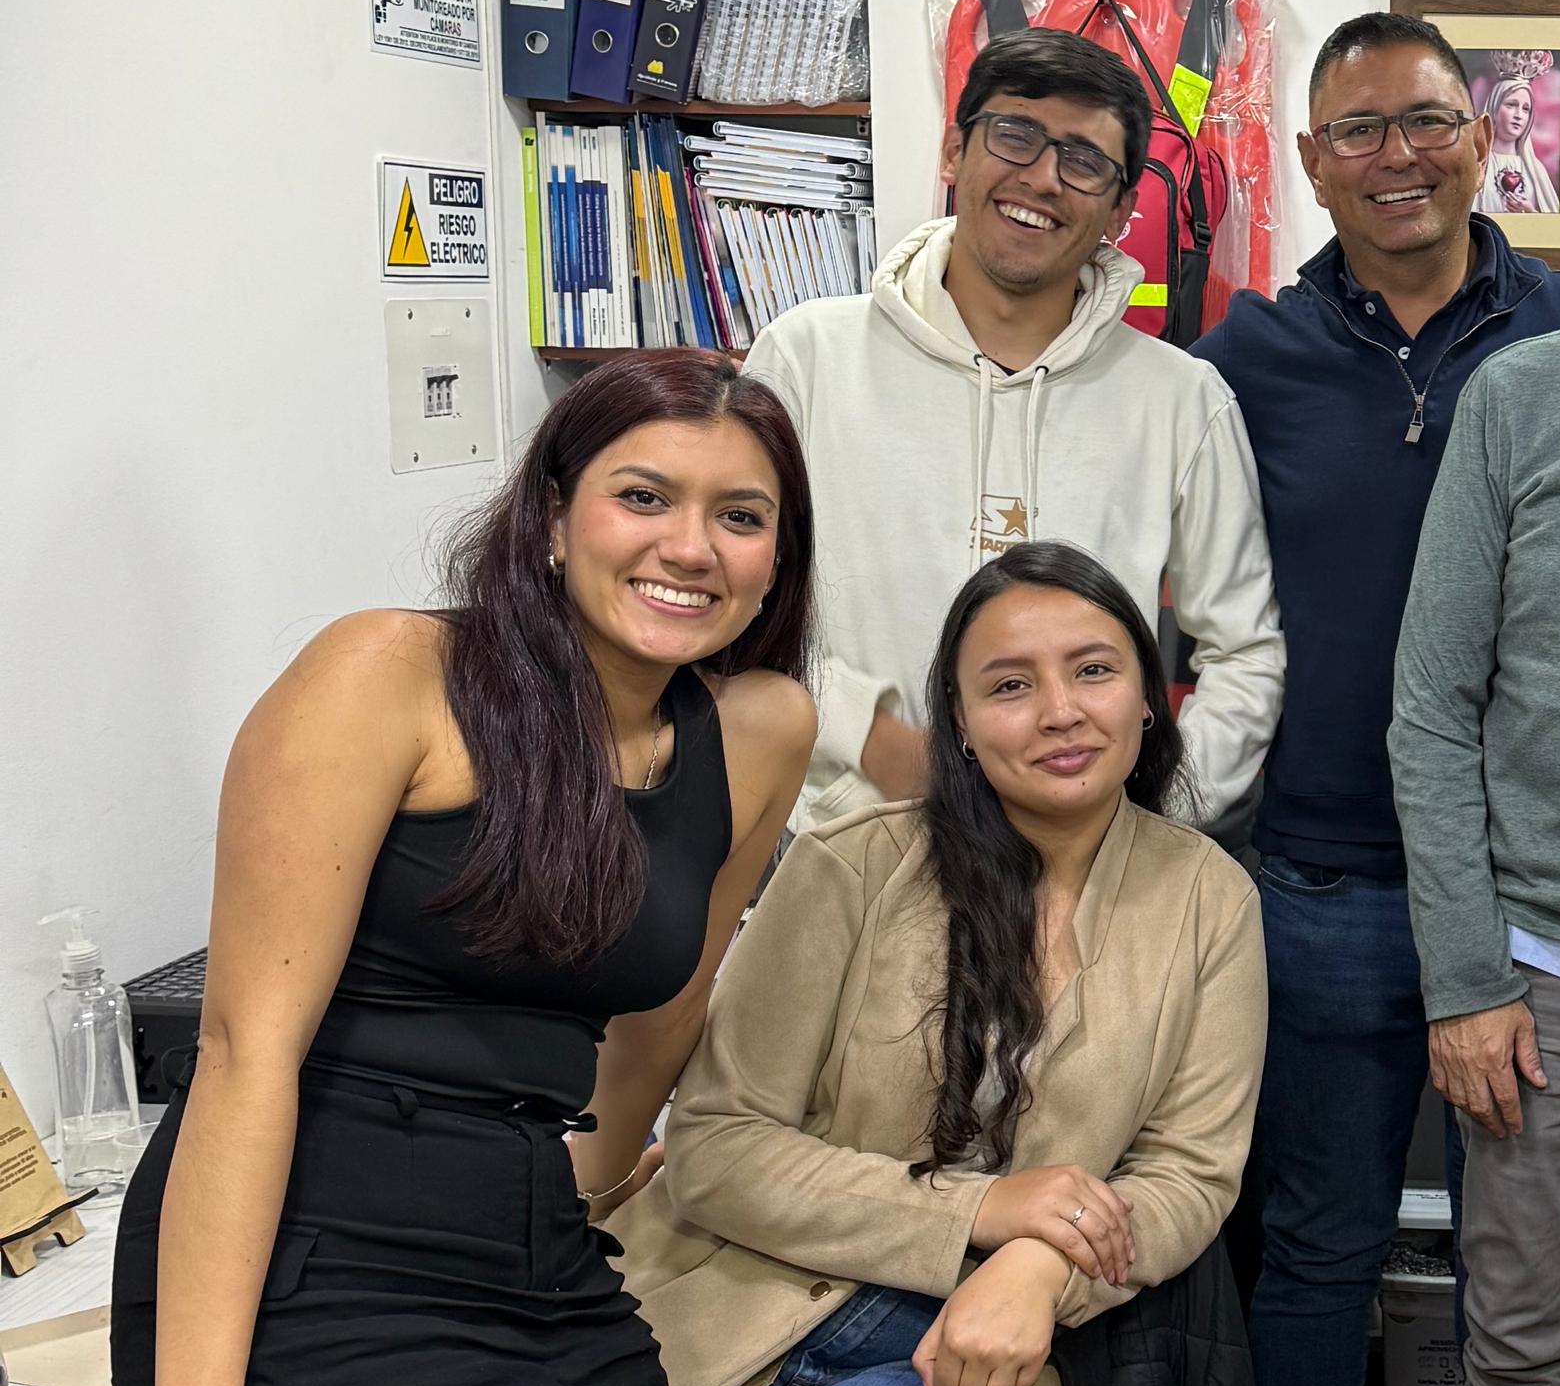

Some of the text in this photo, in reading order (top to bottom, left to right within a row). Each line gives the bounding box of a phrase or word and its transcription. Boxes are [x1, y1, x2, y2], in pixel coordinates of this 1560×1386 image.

[462, 7, 475, 22] POR
[433, 176, 479, 205] PELIGRO
[438, 213, 477, 237] RIESGO
[430, 237, 487, 265] ELÉCTRICO
